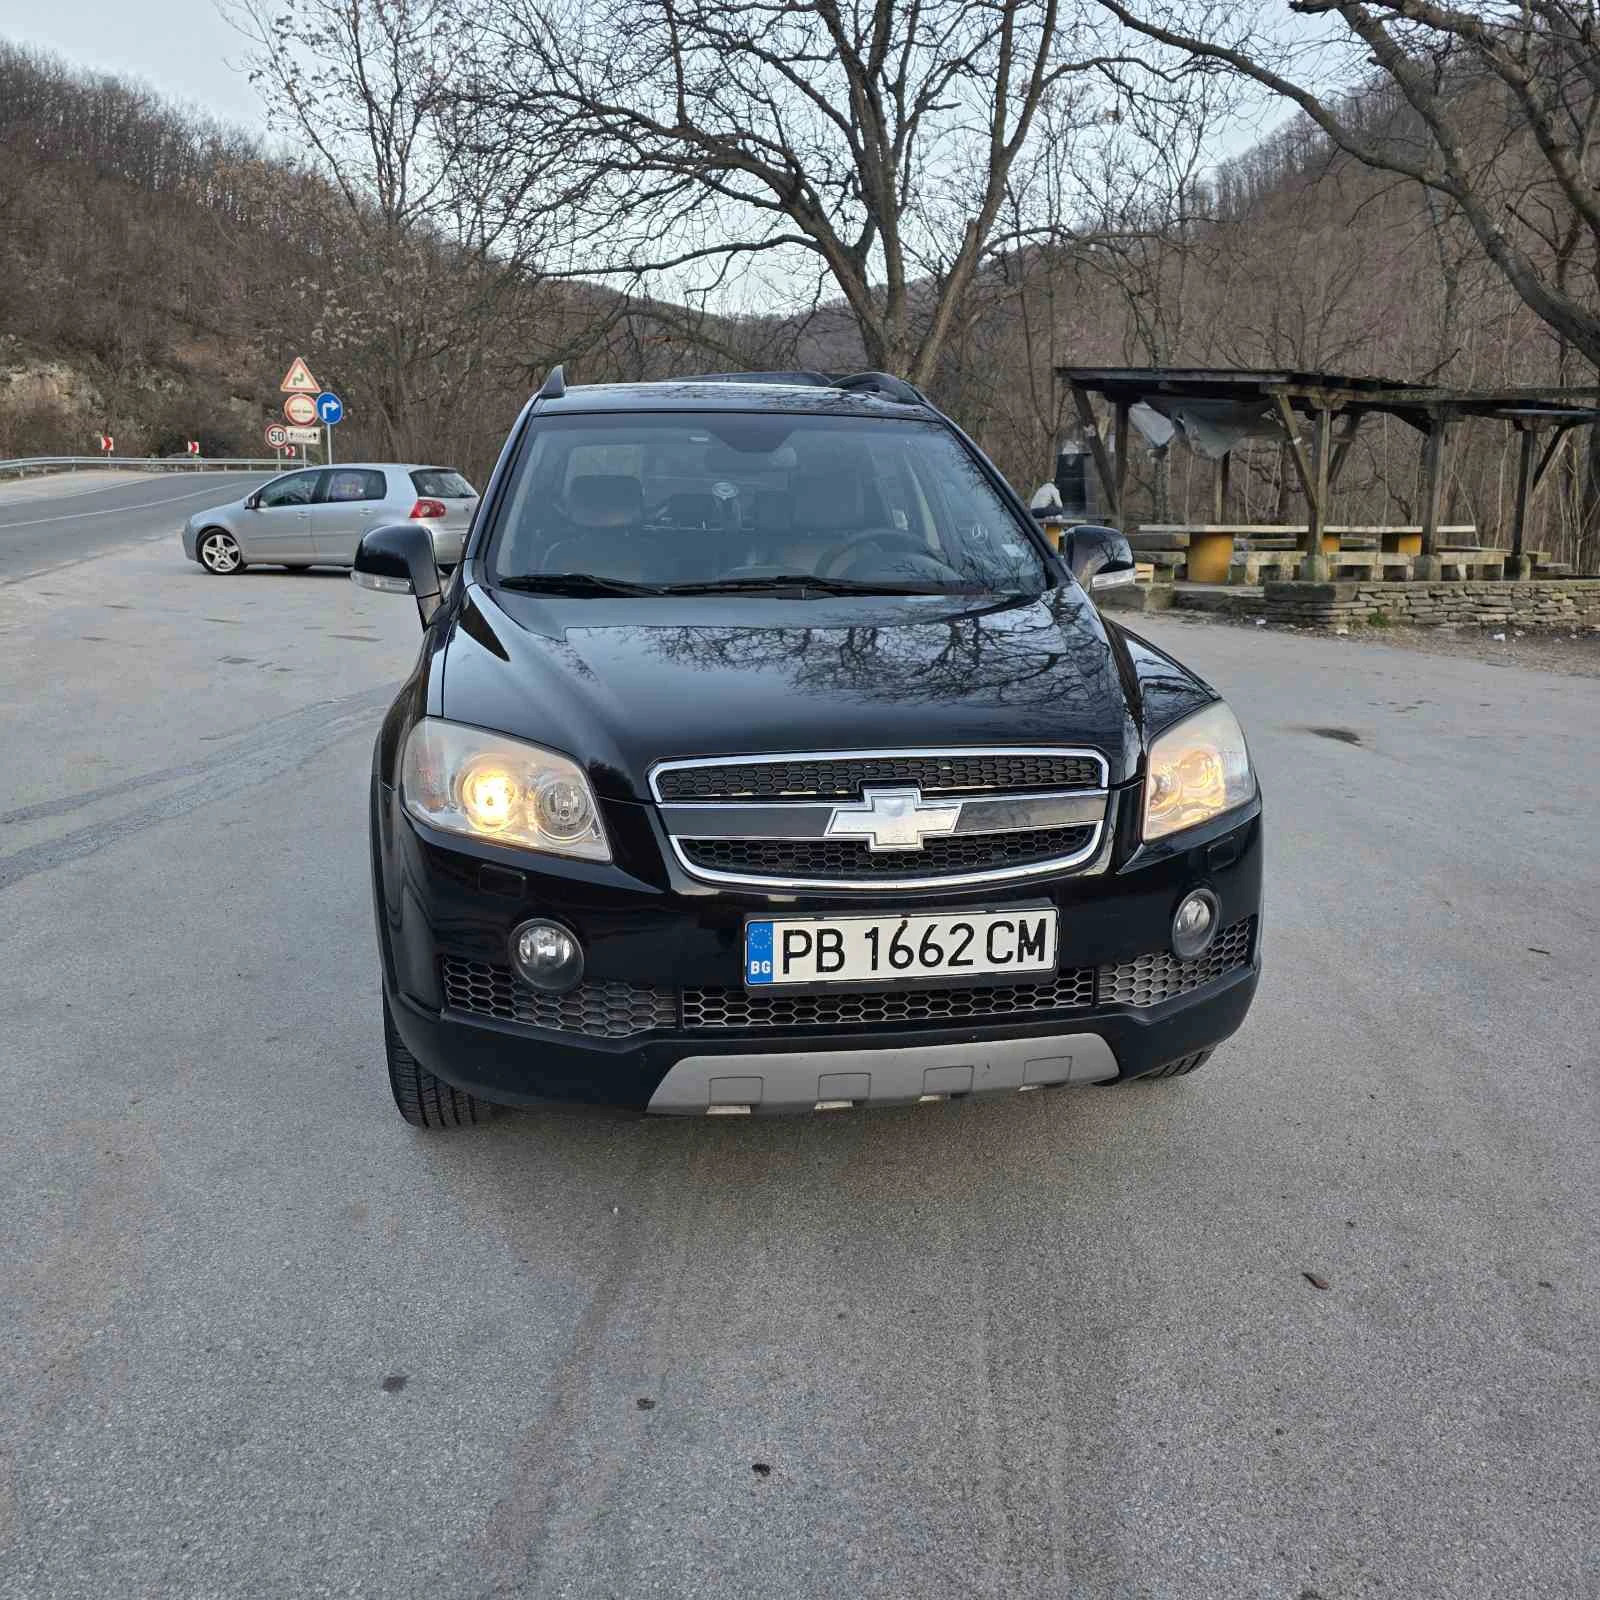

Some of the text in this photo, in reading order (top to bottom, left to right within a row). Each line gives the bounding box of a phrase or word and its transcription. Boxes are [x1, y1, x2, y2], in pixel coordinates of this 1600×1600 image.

[270, 431, 284, 442] 50
[783, 918, 1047, 974] PB 1662 CM
[750, 960, 771, 975] BG
